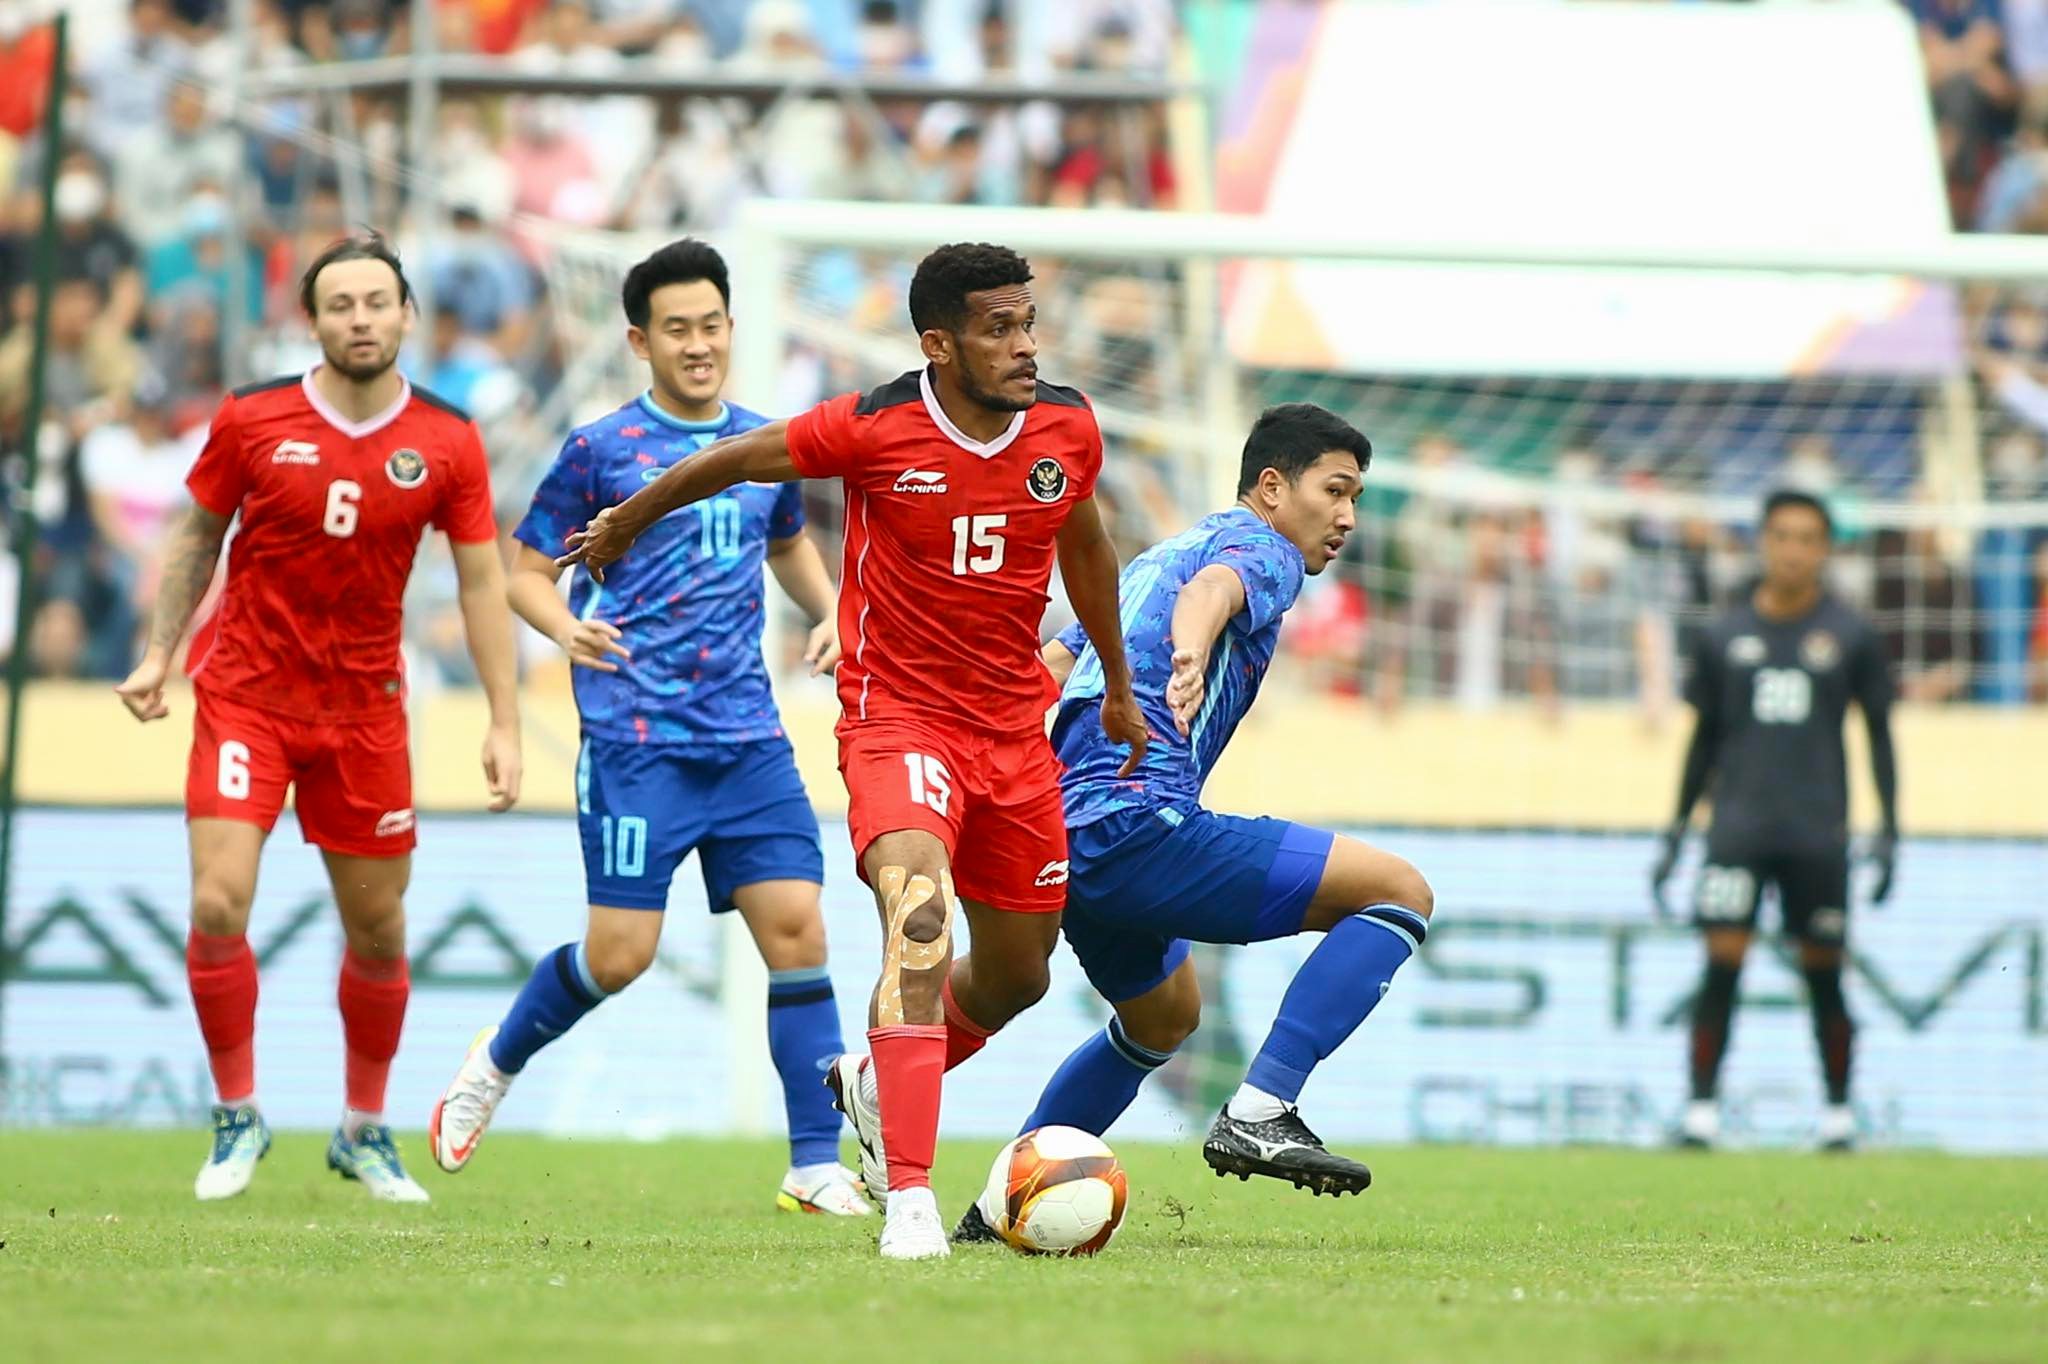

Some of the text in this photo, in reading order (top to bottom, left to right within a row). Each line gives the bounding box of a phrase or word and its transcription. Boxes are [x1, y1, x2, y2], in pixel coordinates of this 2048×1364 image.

[322, 478, 362, 538] 6
[893, 483, 948, 494] LI-NING
[695, 497, 742, 559] 10
[951, 514, 1007, 575] 15
[218, 740, 251, 800] 6
[904, 752, 951, 817] 15
[601, 815, 648, 877] 10
